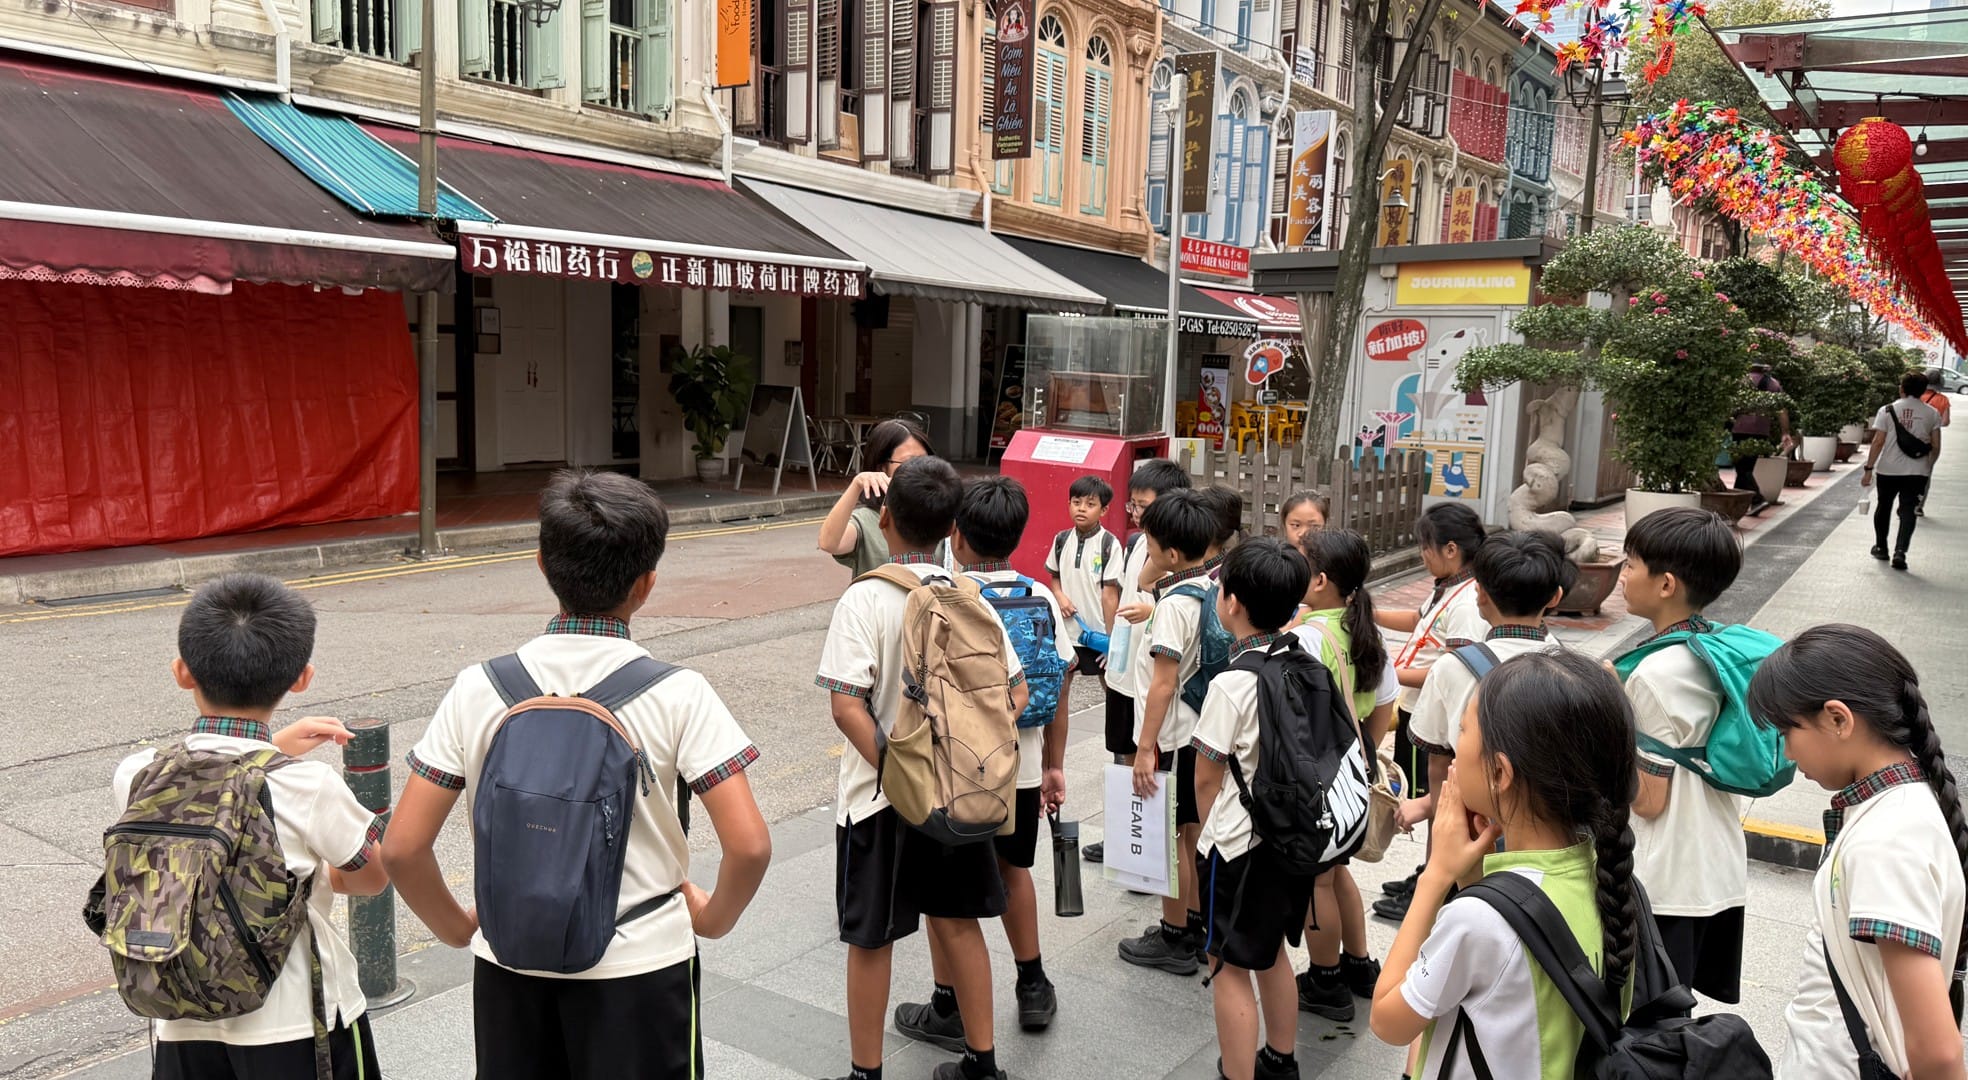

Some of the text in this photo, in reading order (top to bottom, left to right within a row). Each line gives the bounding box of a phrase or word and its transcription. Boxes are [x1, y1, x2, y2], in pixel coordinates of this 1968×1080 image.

[1289, 216, 1316, 225] Facial
[468, 237, 620, 280] 万裕和药行
[660, 256, 861, 297] 正新加坡荷叶牌药油
[1410, 276, 1516, 289] JOURNALING
[1187, 319, 1204, 334] GAS
[1247, 340, 1271, 356] HAPPY
[1274, 341, 1289, 356] MAIL
[1130, 792, 1143, 856] TEAM B
